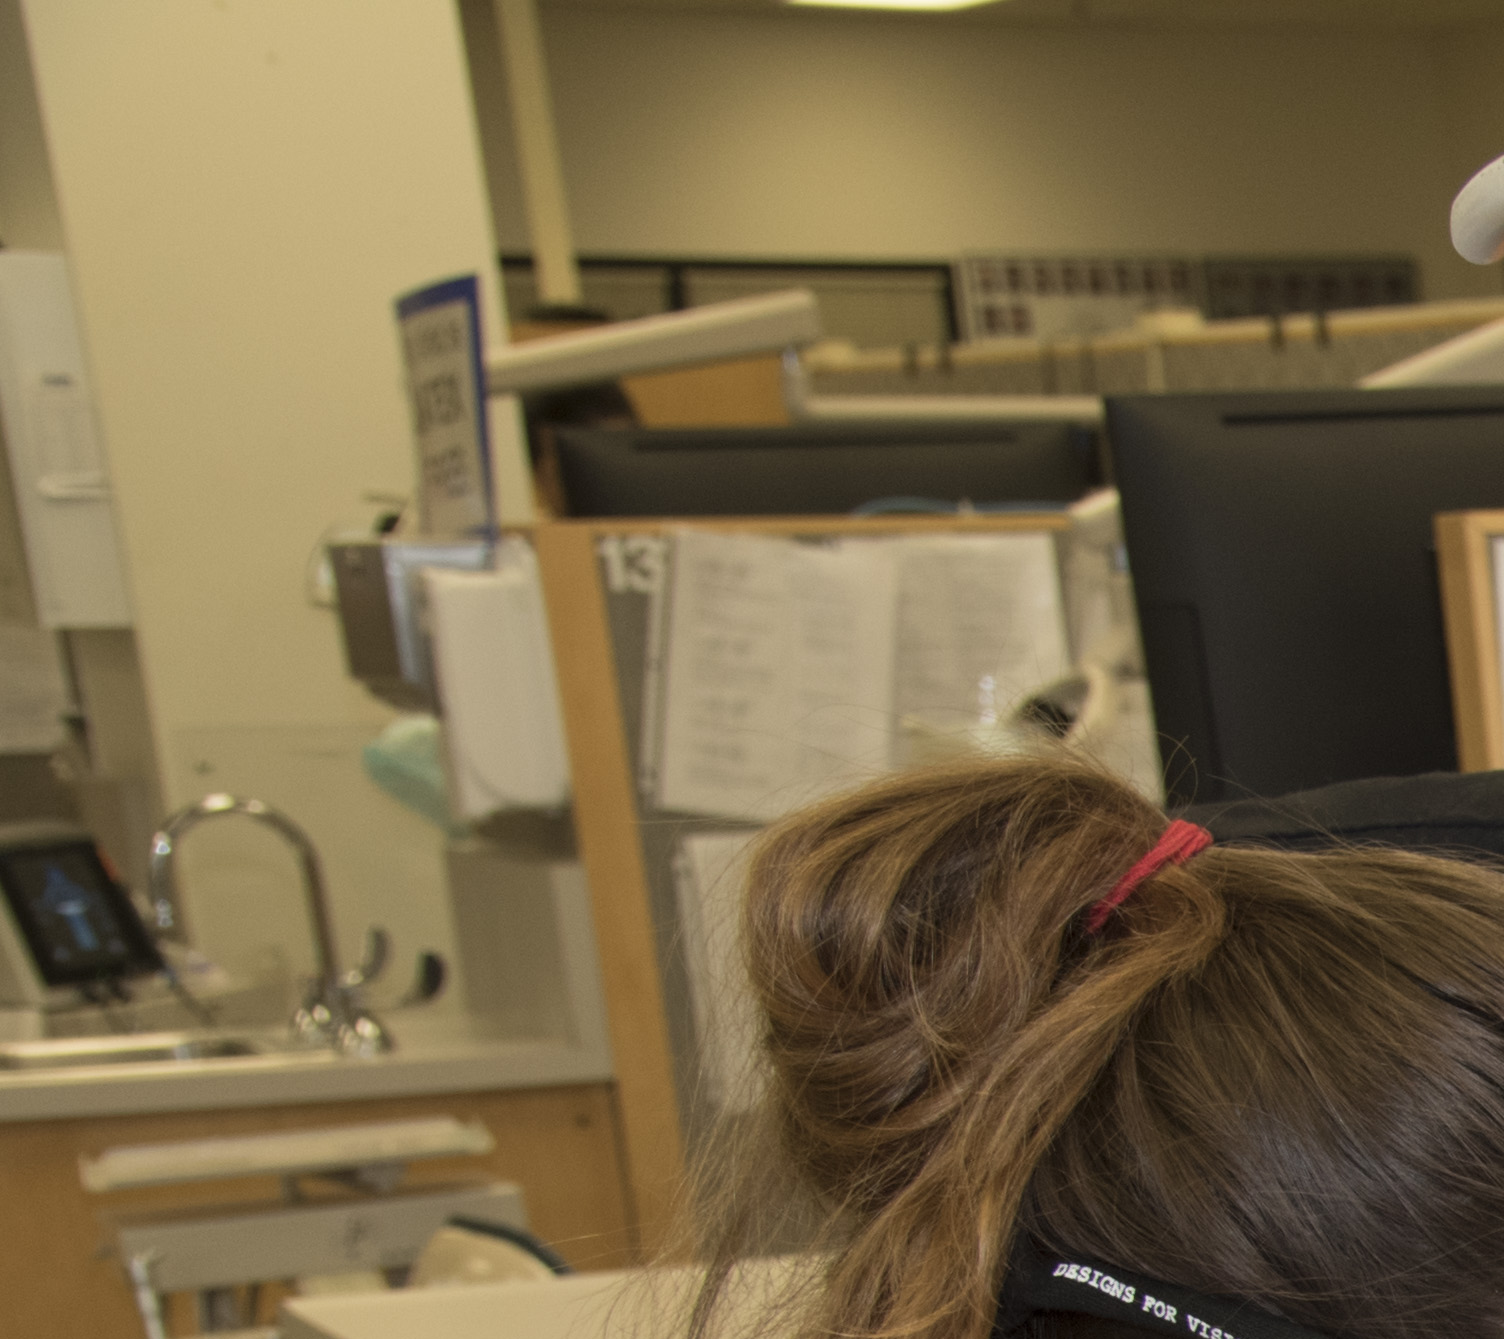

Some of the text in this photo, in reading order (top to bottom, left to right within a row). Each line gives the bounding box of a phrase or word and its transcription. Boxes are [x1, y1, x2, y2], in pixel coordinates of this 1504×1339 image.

[595, 536, 666, 593] 13
[1053, 1263, 1135, 1303] DESIGNS
[1142, 1294, 1177, 1324] FOR
